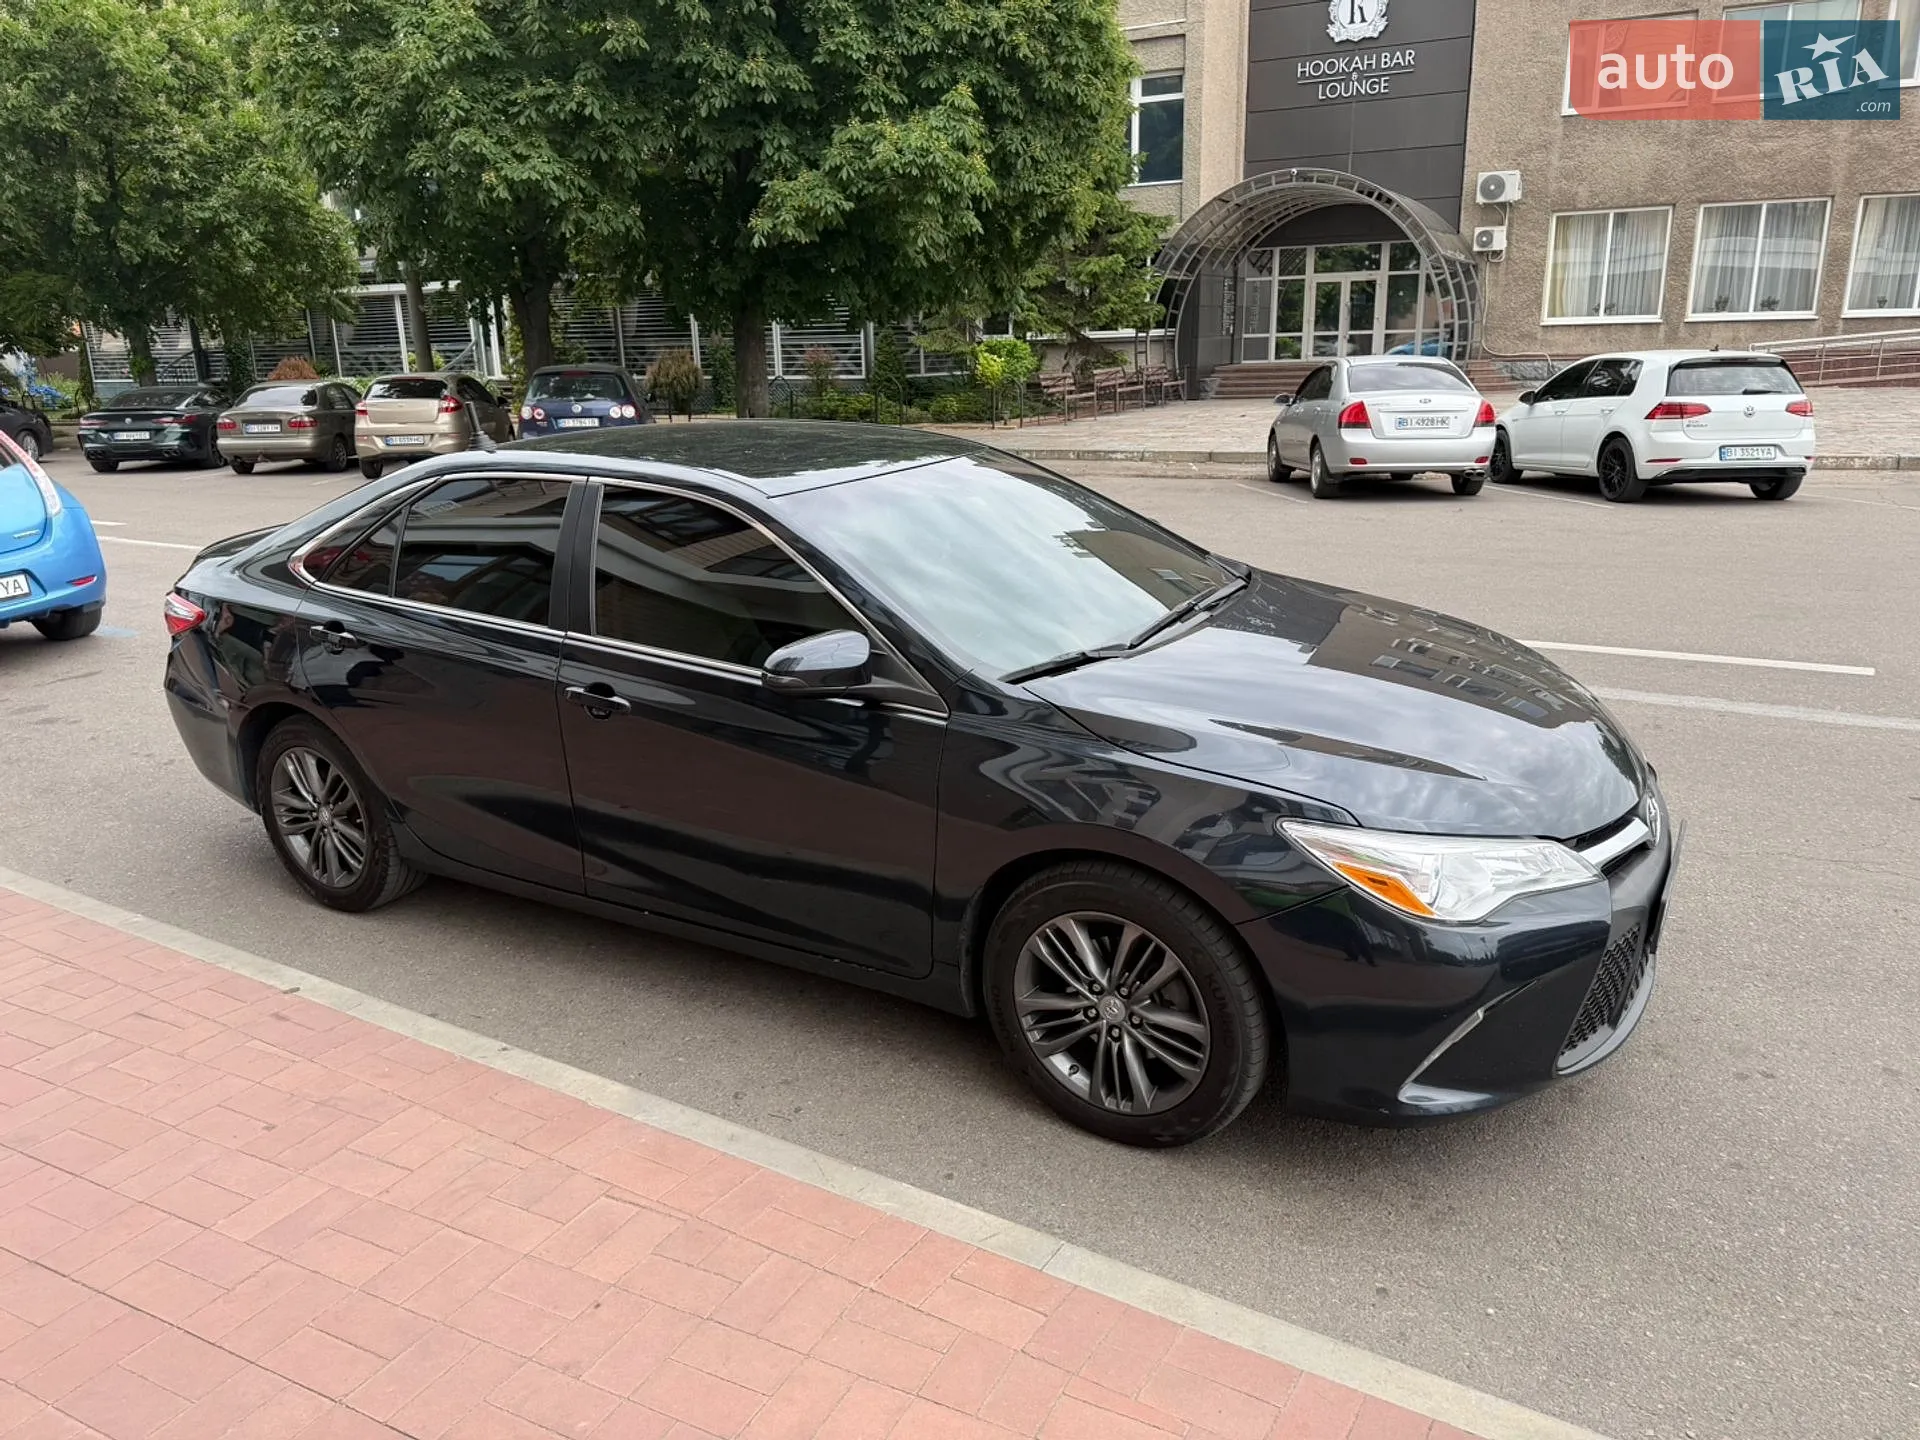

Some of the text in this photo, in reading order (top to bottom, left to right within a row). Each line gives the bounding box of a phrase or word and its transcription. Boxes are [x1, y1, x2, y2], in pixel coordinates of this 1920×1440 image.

[1297, 49, 1415, 78] HOOKAH BAR
[1318, 77, 1390, 100] LOUNGE
[0, 575, 24, 595] YA
